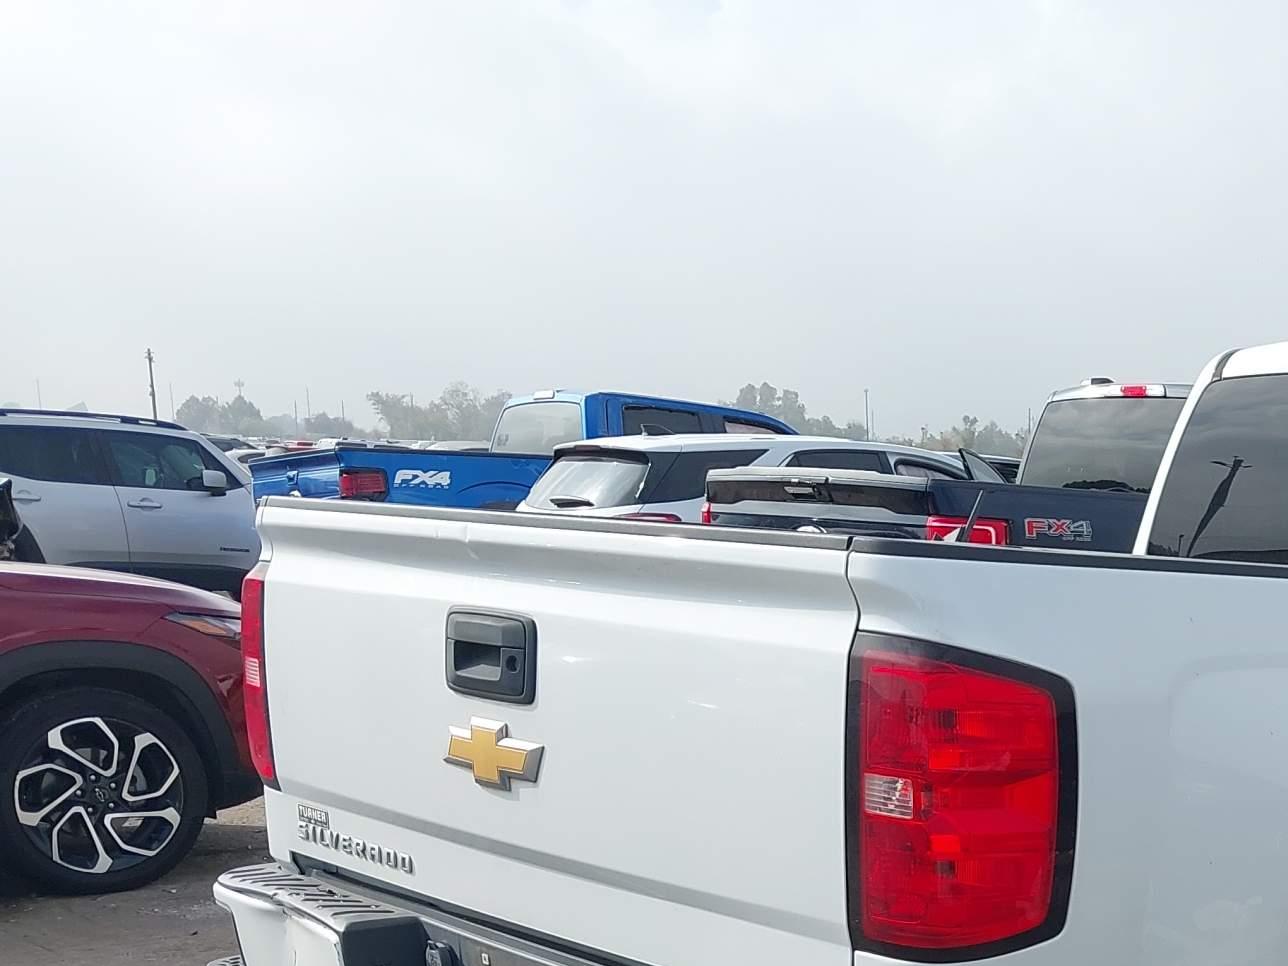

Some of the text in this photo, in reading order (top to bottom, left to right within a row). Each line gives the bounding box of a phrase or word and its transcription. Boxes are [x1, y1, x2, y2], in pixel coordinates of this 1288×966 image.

[394, 469, 451, 485] FX4
[1024, 518, 1092, 539] FX4
[298, 805, 327, 824] TURNER
[298, 823, 415, 877] SILVERADO
